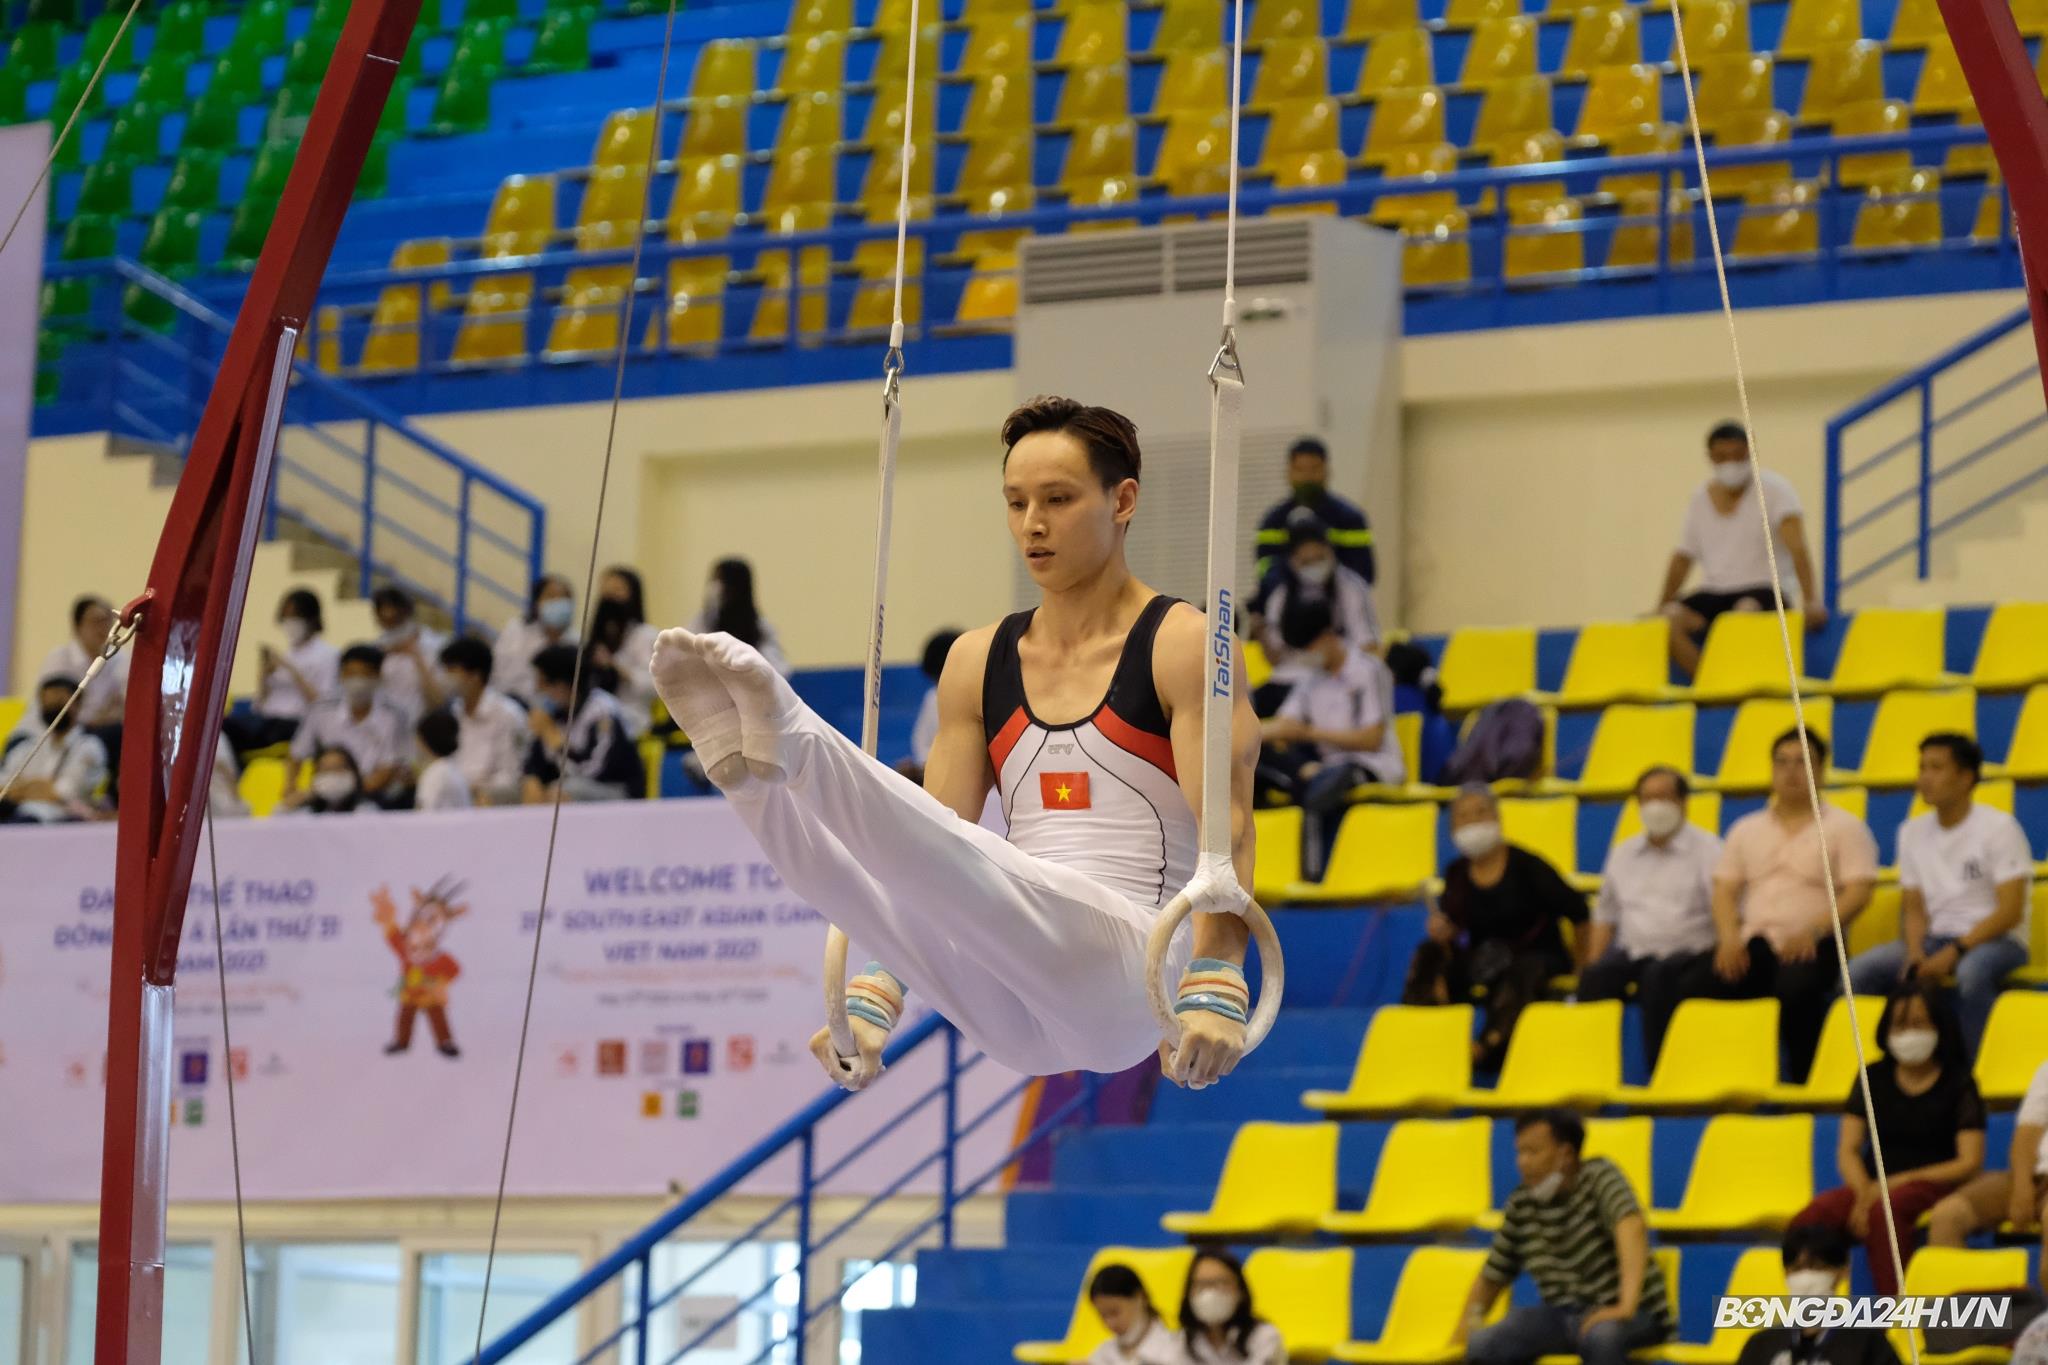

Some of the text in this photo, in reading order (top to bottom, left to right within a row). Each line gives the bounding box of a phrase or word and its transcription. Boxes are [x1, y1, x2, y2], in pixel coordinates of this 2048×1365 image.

[1213, 588, 1231, 697] TaiShan
[584, 861, 783, 892] WELCOME TO
[242, 879, 315, 904] THAO
[702, 905, 767, 927] ASIAN
[774, 902, 824, 925] GAM
[658, 941, 709, 960] NAM
